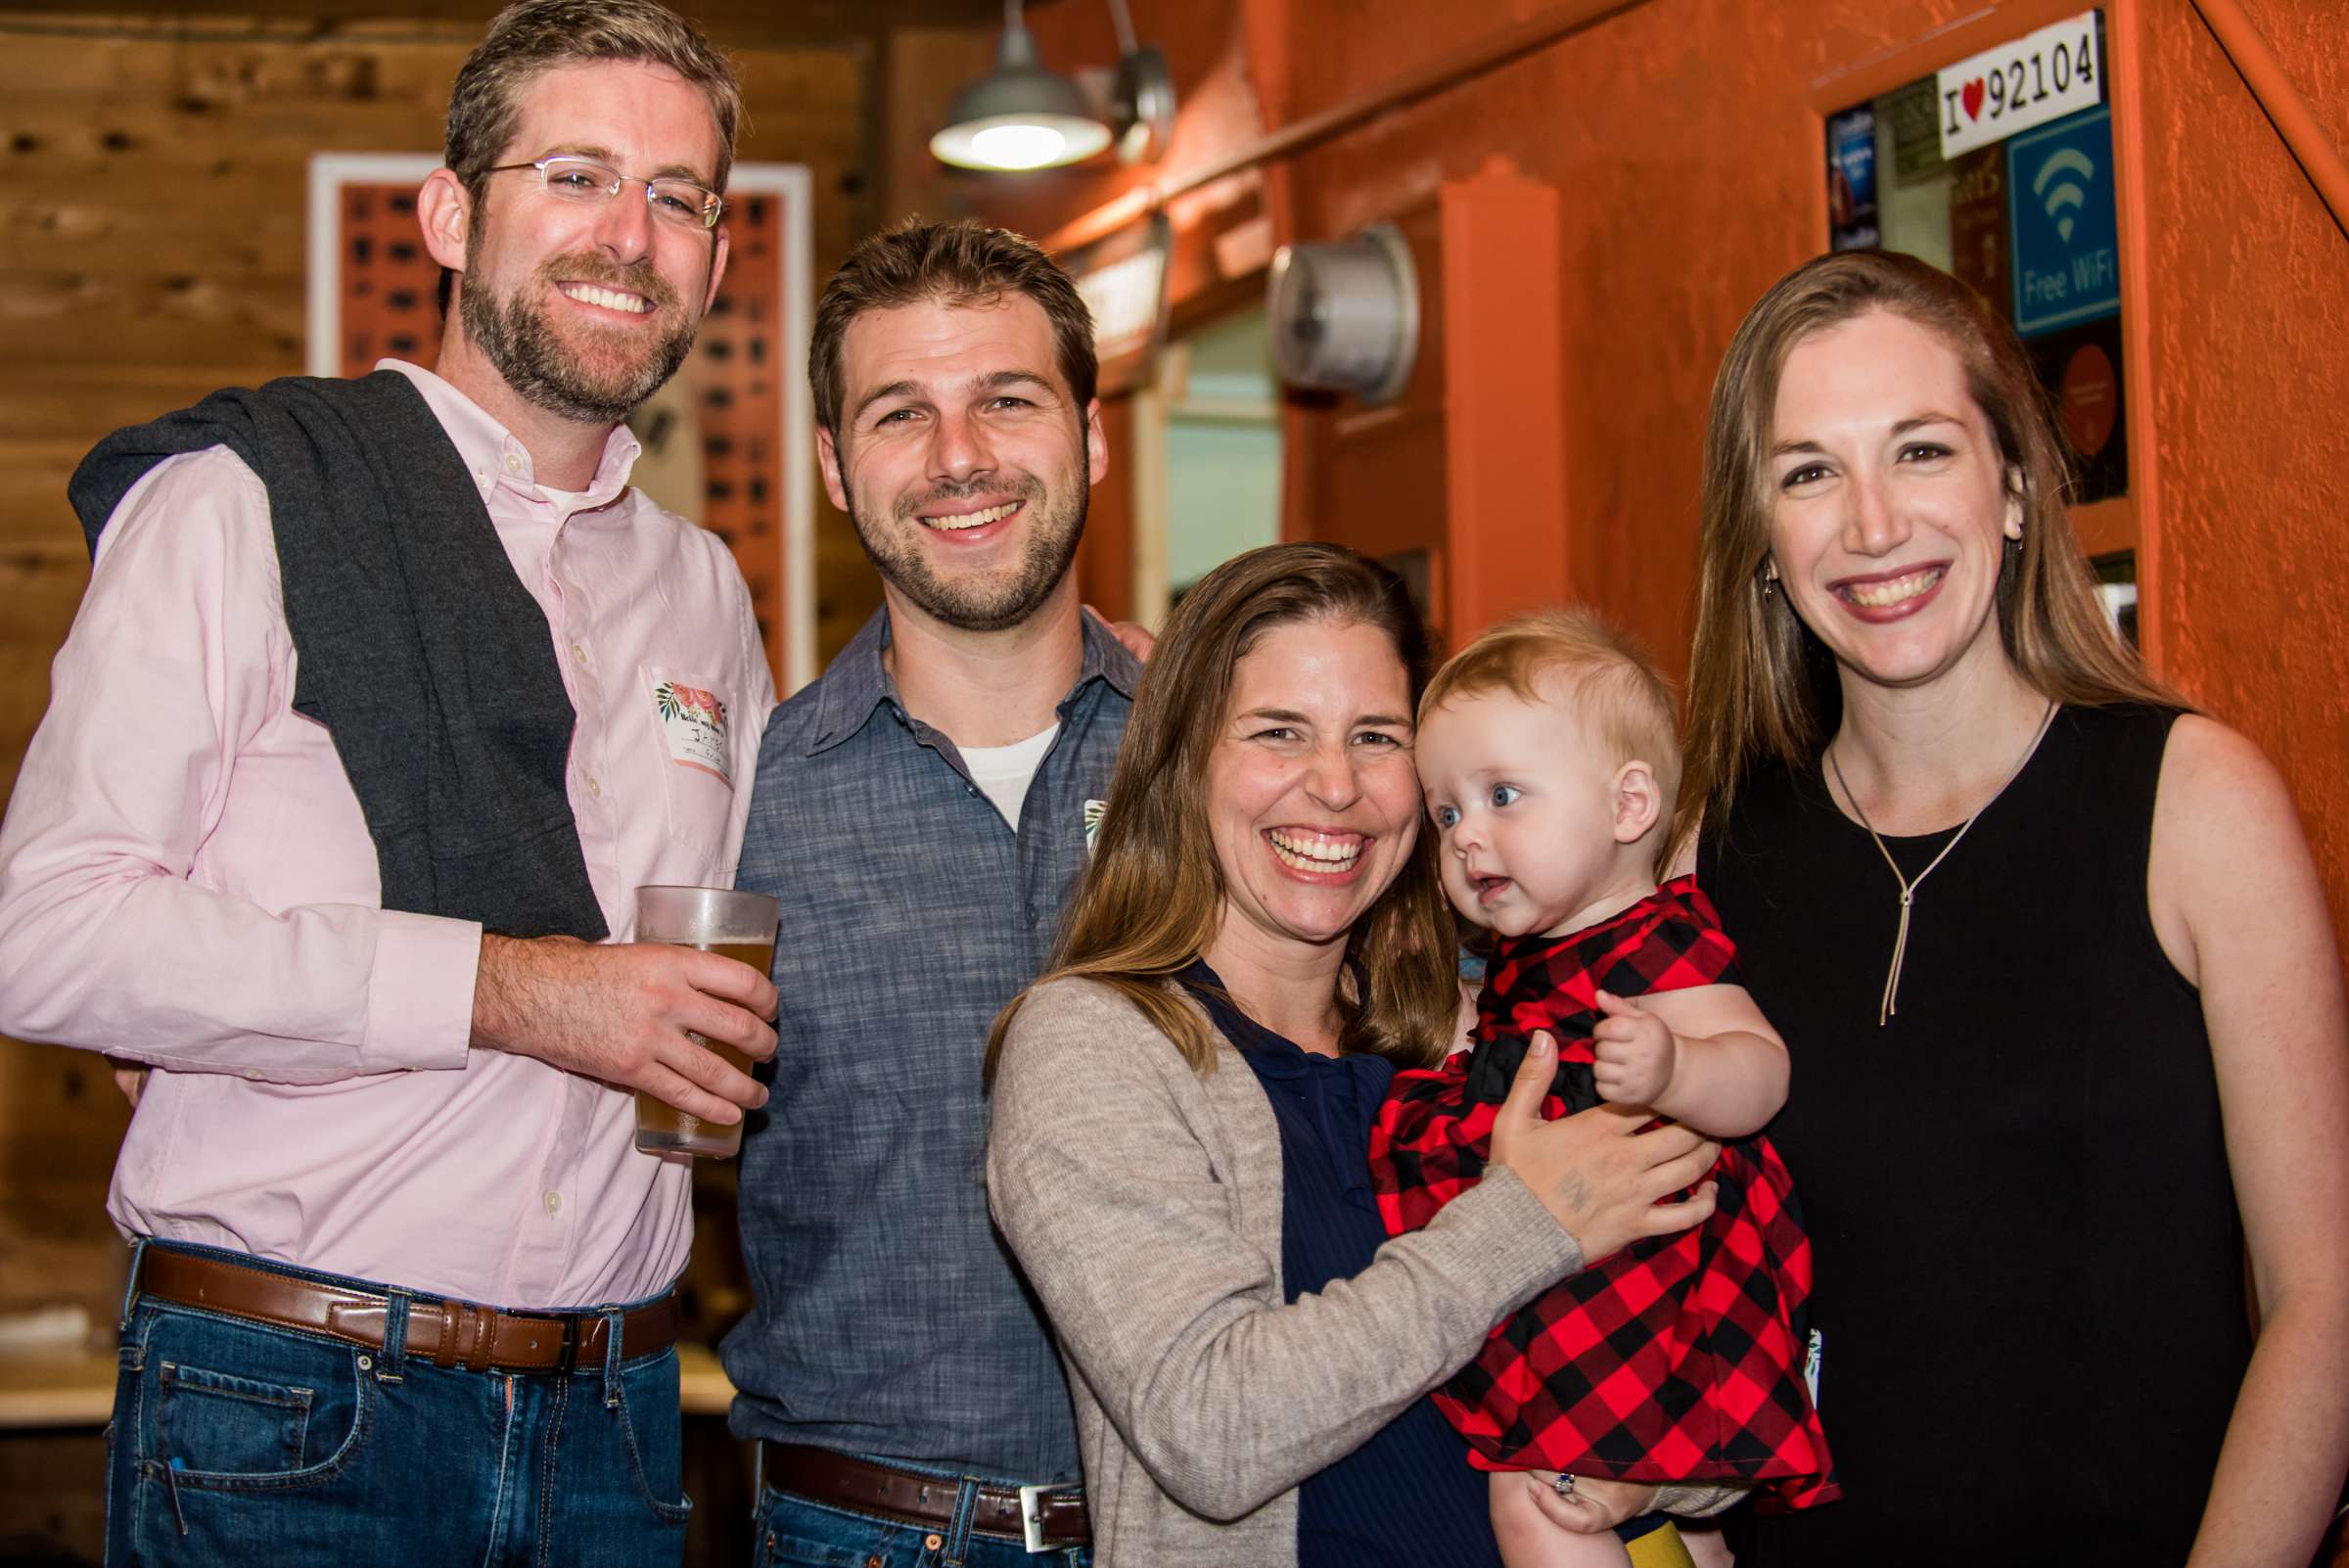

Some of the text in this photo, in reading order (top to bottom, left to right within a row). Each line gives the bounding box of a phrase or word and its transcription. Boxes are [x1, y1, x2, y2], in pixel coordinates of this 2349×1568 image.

[1945, 89, 1960, 136] I
[1989, 33, 2093, 119] 92104
[2024, 249, 2114, 306] Free WiFi
